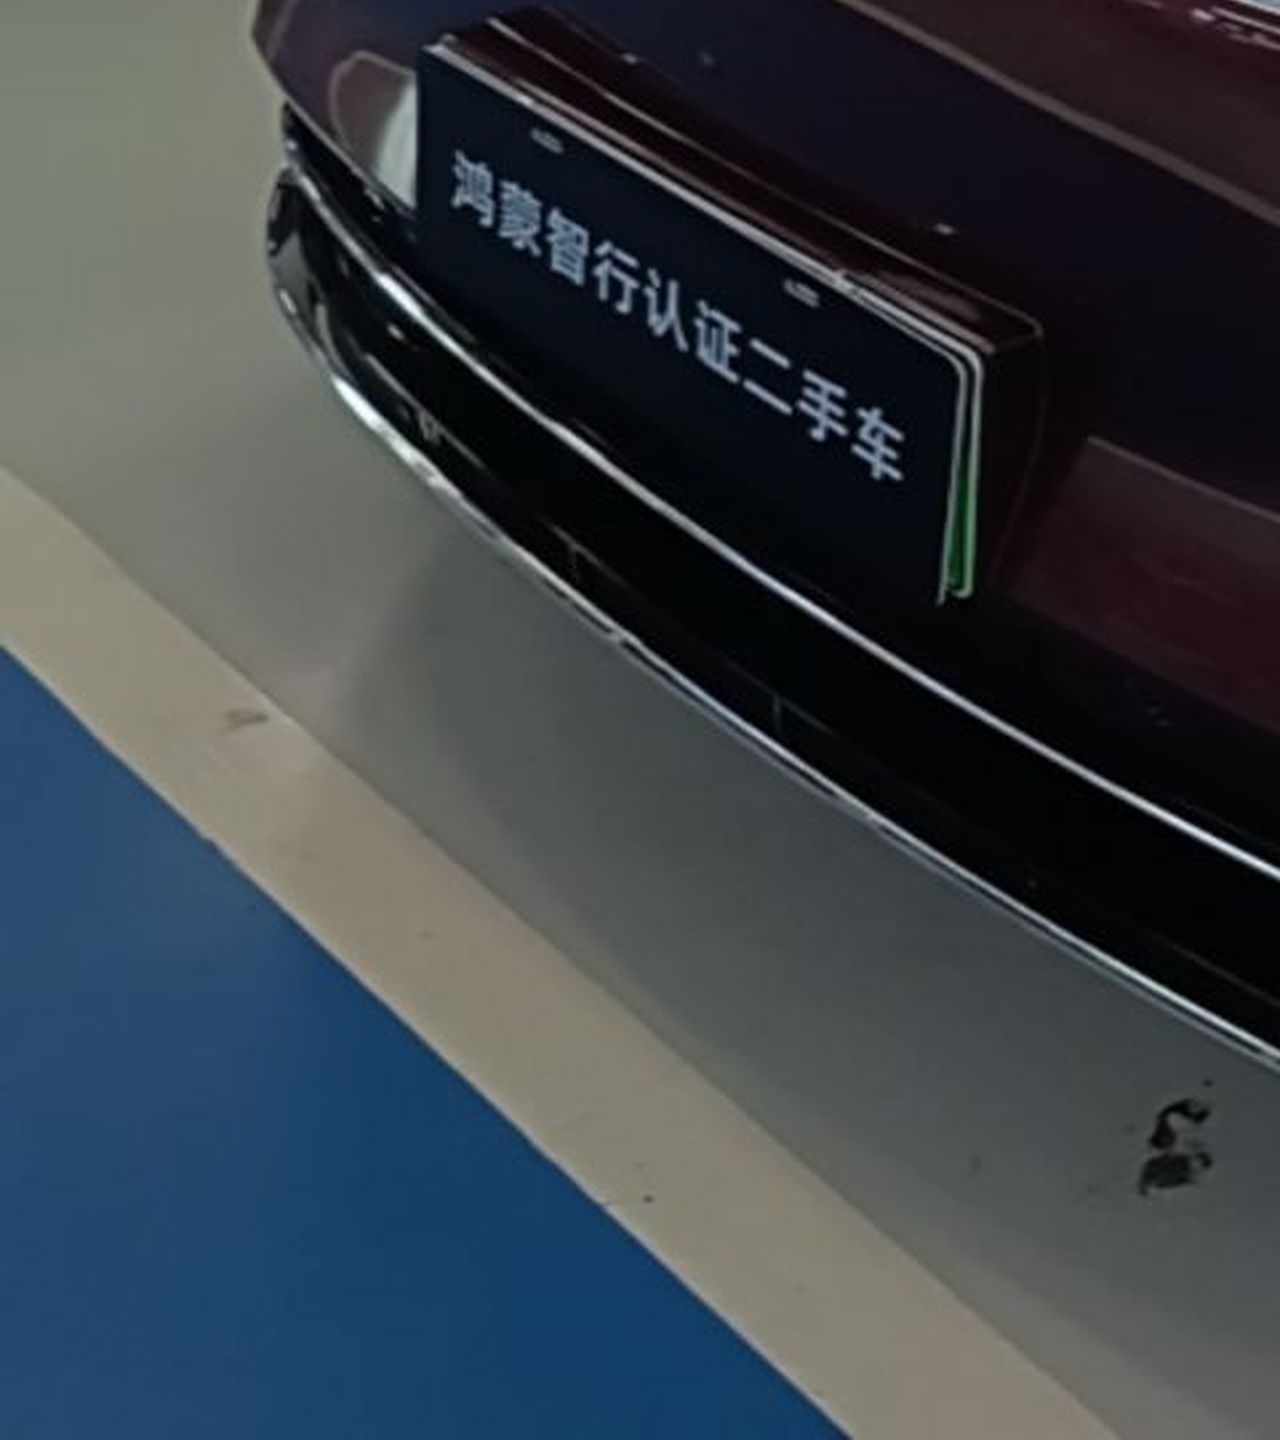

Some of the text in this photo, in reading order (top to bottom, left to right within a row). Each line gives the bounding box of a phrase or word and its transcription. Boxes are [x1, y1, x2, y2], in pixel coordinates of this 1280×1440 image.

[451, 150, 904, 482] 鸿蒙智行认证二手车
